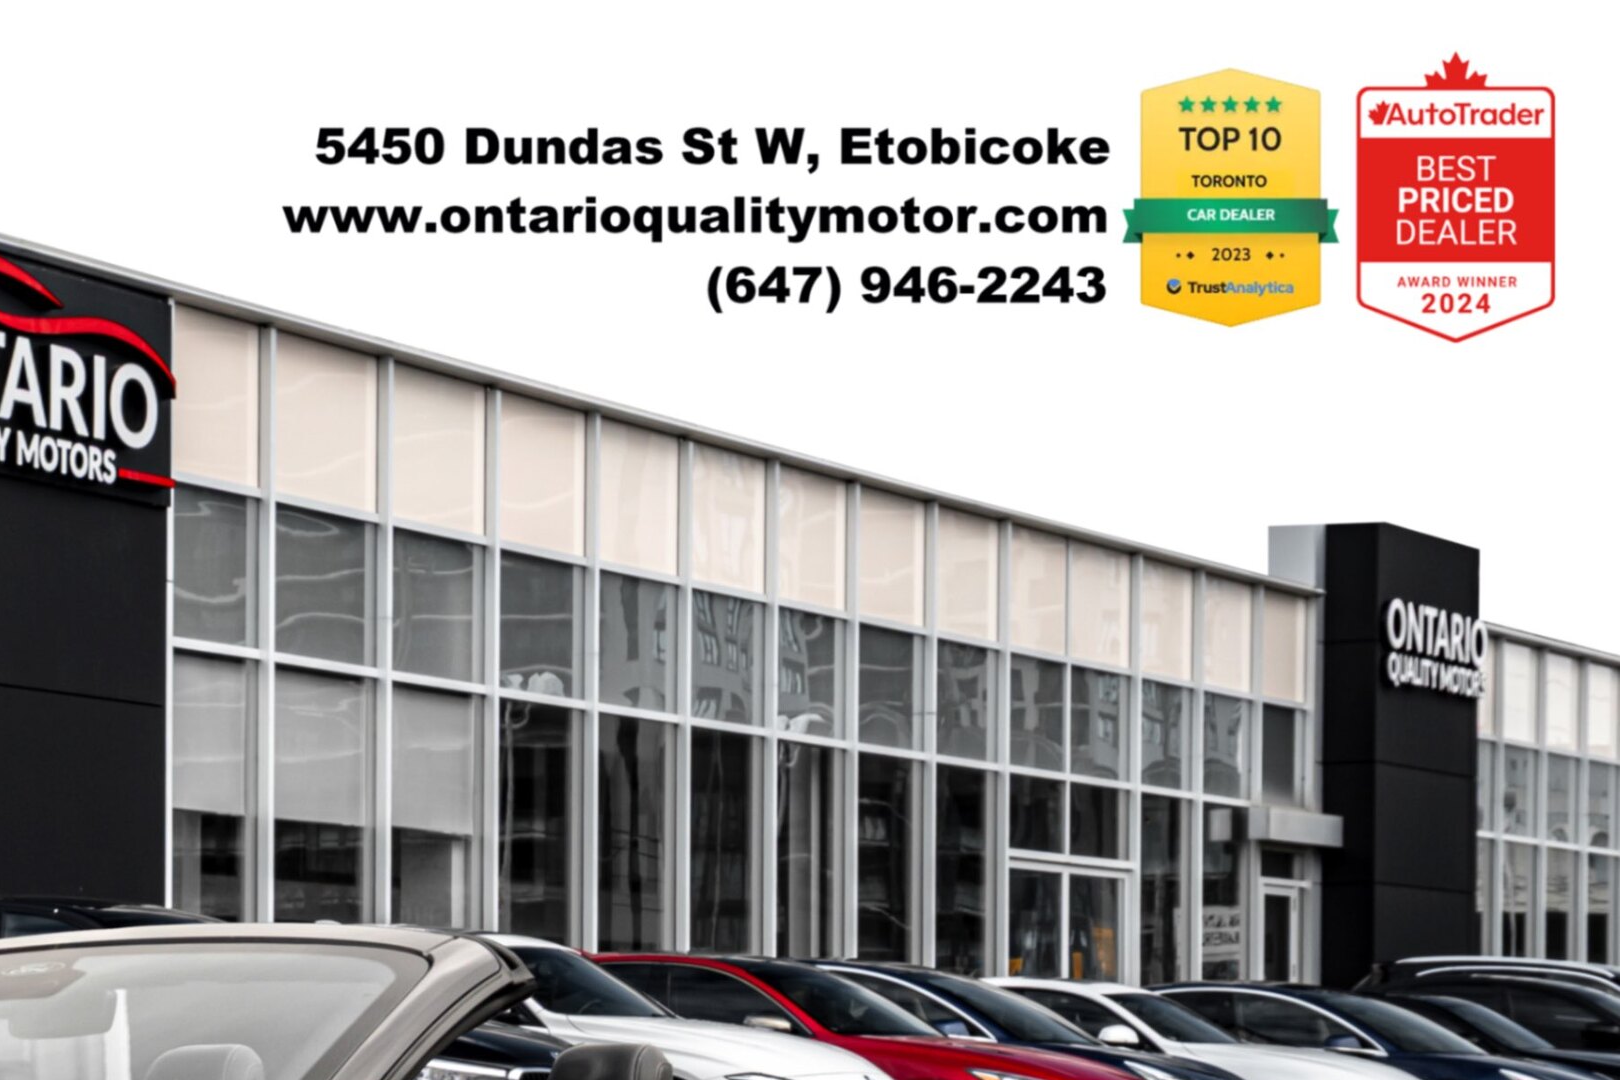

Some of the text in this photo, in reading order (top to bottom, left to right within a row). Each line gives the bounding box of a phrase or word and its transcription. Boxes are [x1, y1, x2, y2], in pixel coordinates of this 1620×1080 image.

[16, 430, 117, 484] MOTORS
[1387, 597, 1488, 668] ONTARIO
[1387, 651, 1439, 689] QUALITY
